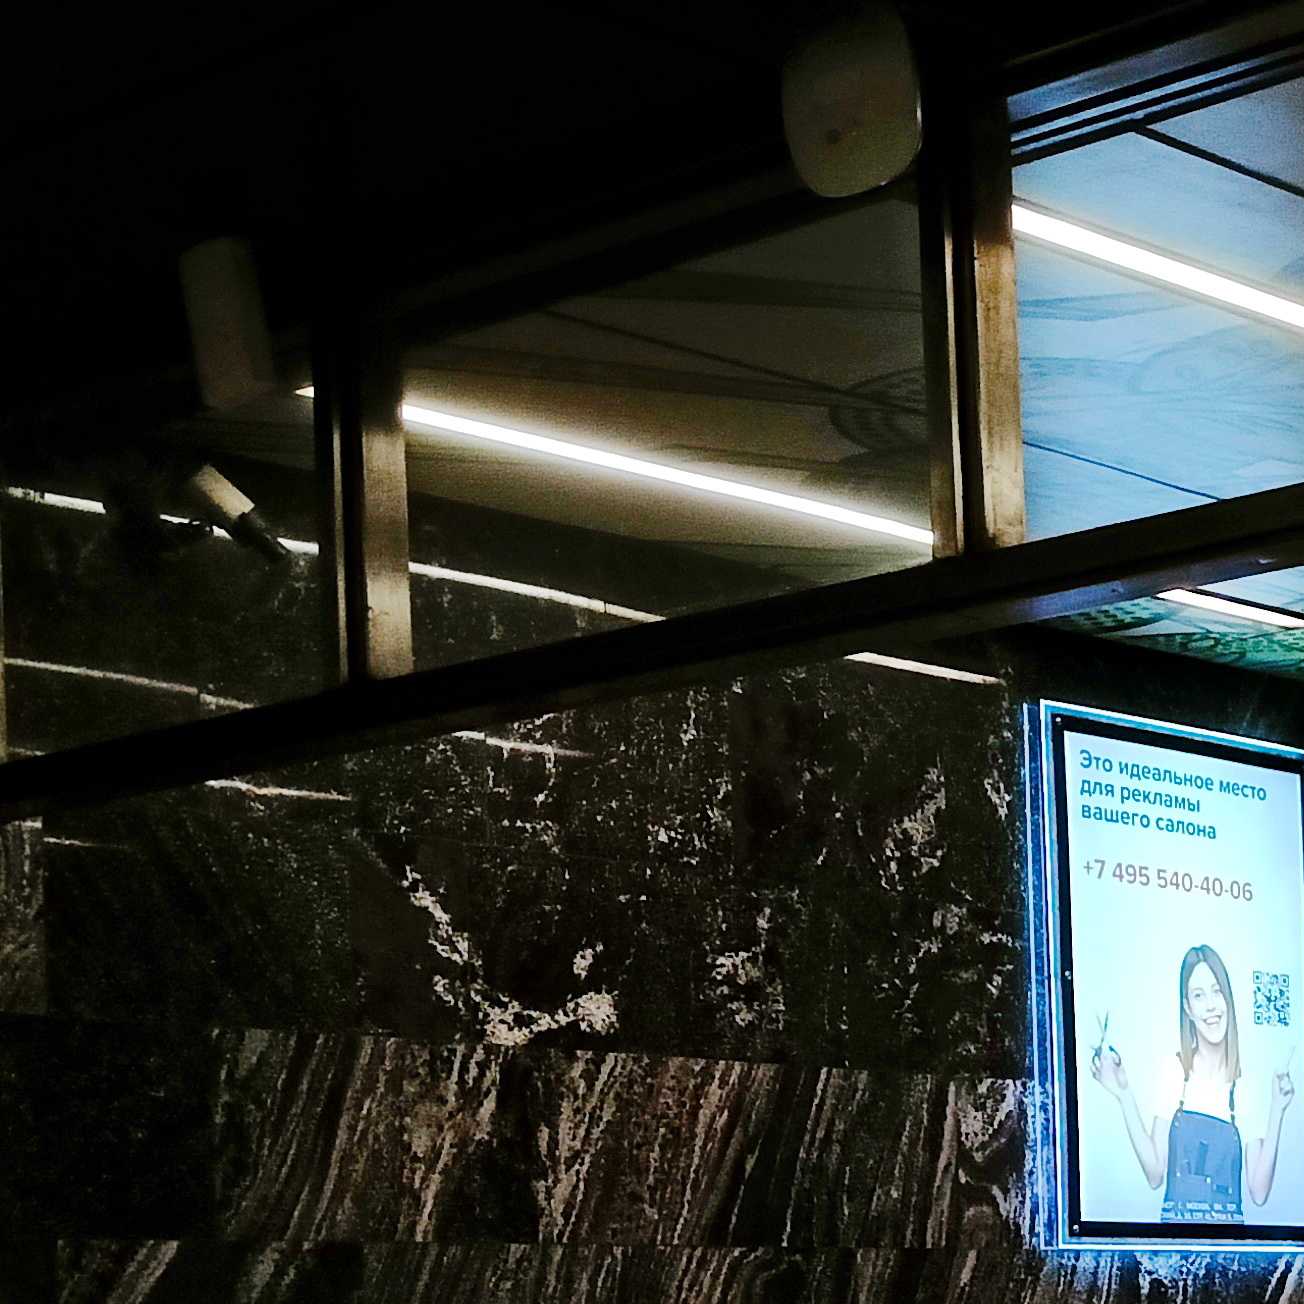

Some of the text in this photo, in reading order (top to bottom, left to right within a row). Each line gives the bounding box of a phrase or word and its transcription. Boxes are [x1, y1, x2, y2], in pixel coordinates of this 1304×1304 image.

[1080, 749, 1267, 801] Это идеальное место
[1080, 779, 1200, 812] для рекламы
[1081, 804, 1217, 839] вашего салона
[1083, 859, 1254, 902] +7 495 540-40-06
